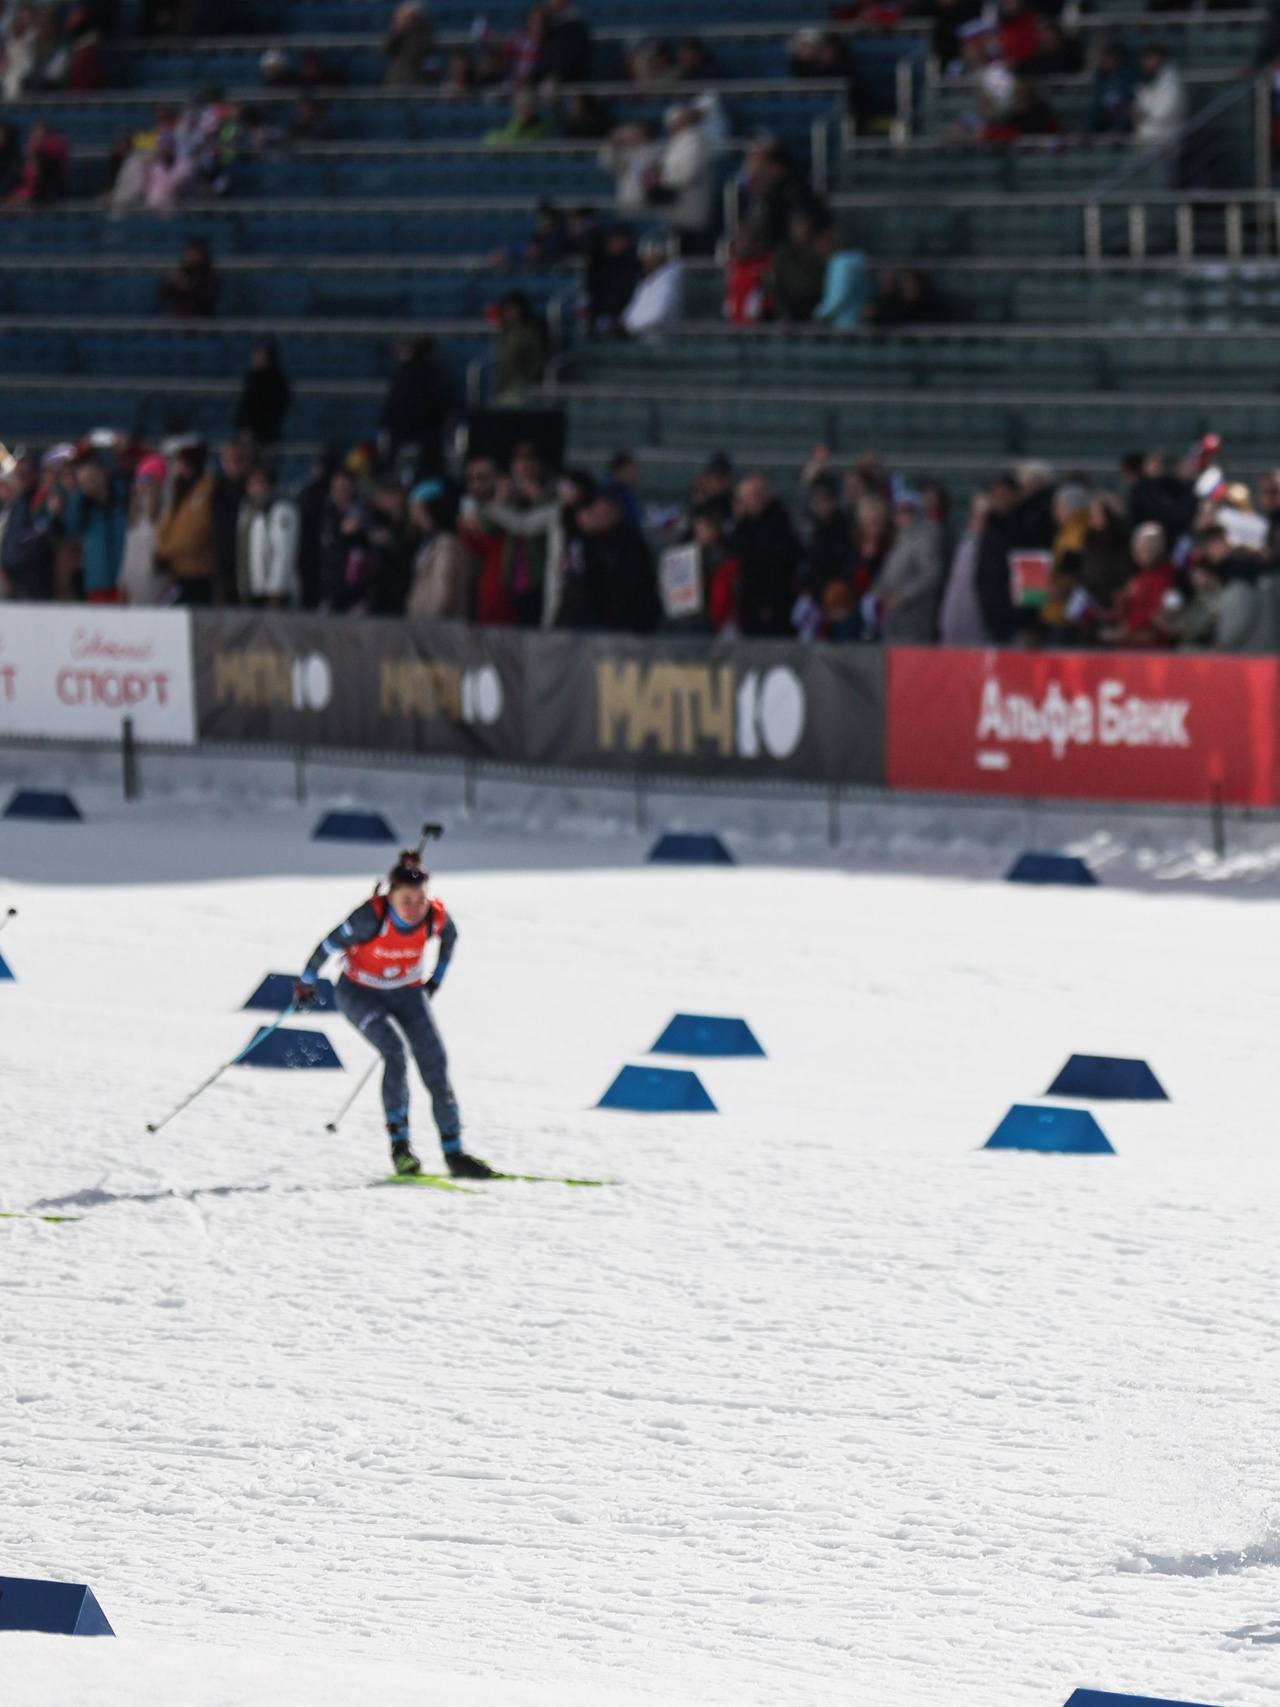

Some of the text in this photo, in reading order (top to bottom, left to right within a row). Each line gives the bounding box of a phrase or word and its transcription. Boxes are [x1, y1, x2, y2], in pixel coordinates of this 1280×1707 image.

[57, 664, 170, 708] СПОРТ
[977, 678, 1189, 768] Альфа Банк
